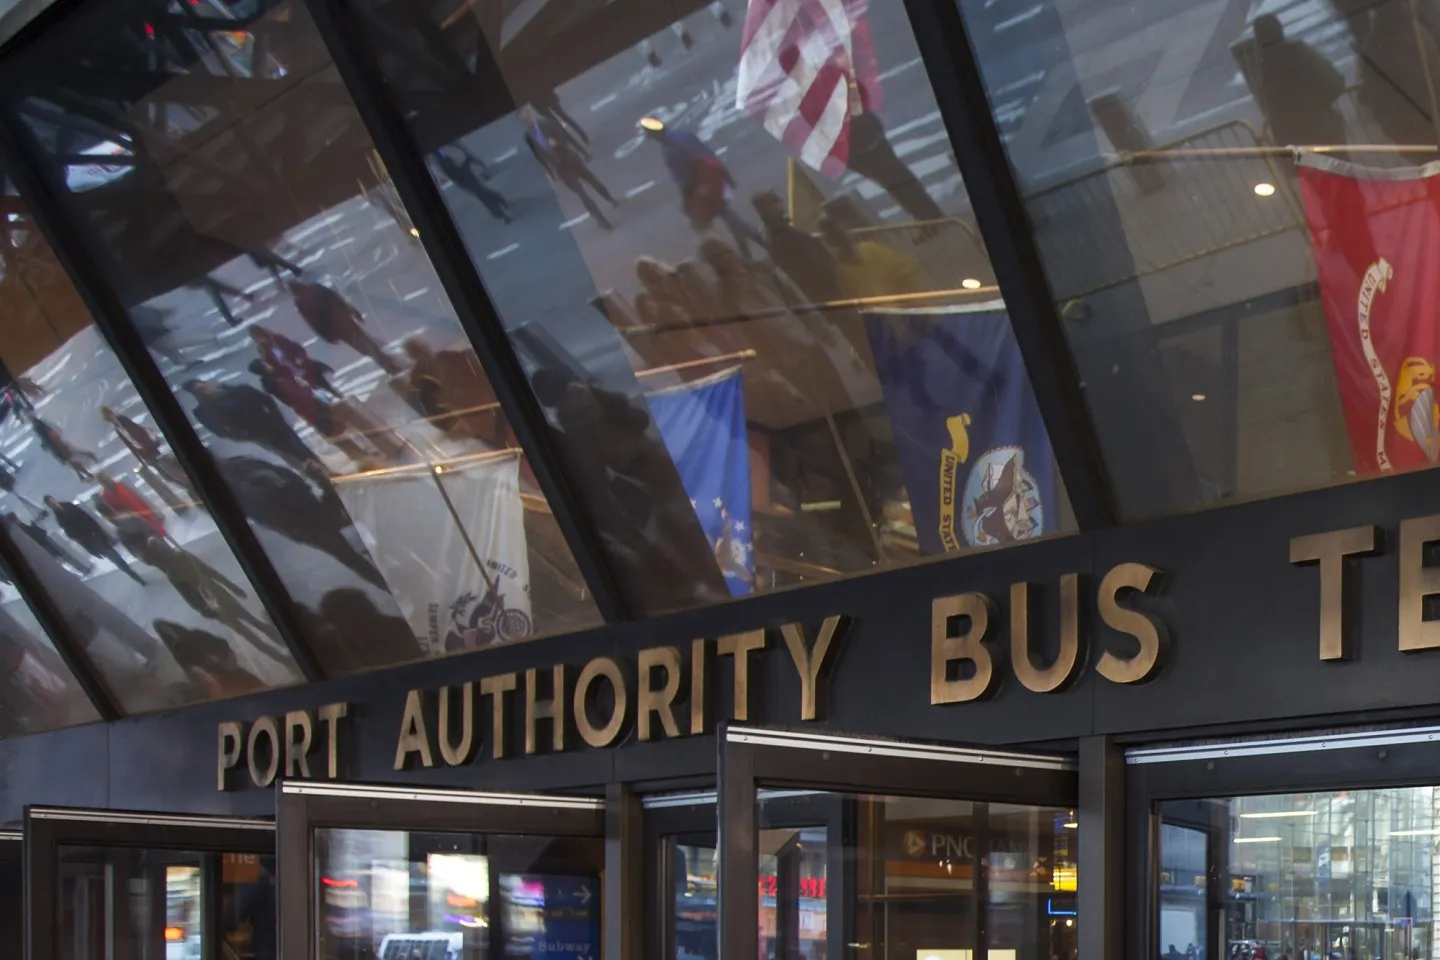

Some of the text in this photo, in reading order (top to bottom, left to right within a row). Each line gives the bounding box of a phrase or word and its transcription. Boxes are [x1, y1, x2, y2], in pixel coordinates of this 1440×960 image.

[1359, 272, 1377, 340] UNITED
[1370, 357, 1388, 431] STATES
[943, 455, 956, 505] UNITED
[217, 702, 349, 791] PORT
[393, 614, 845, 770] AUTHORITY
[930, 561, 1166, 705] BUS
[537, 940, 591, 954] Subway
